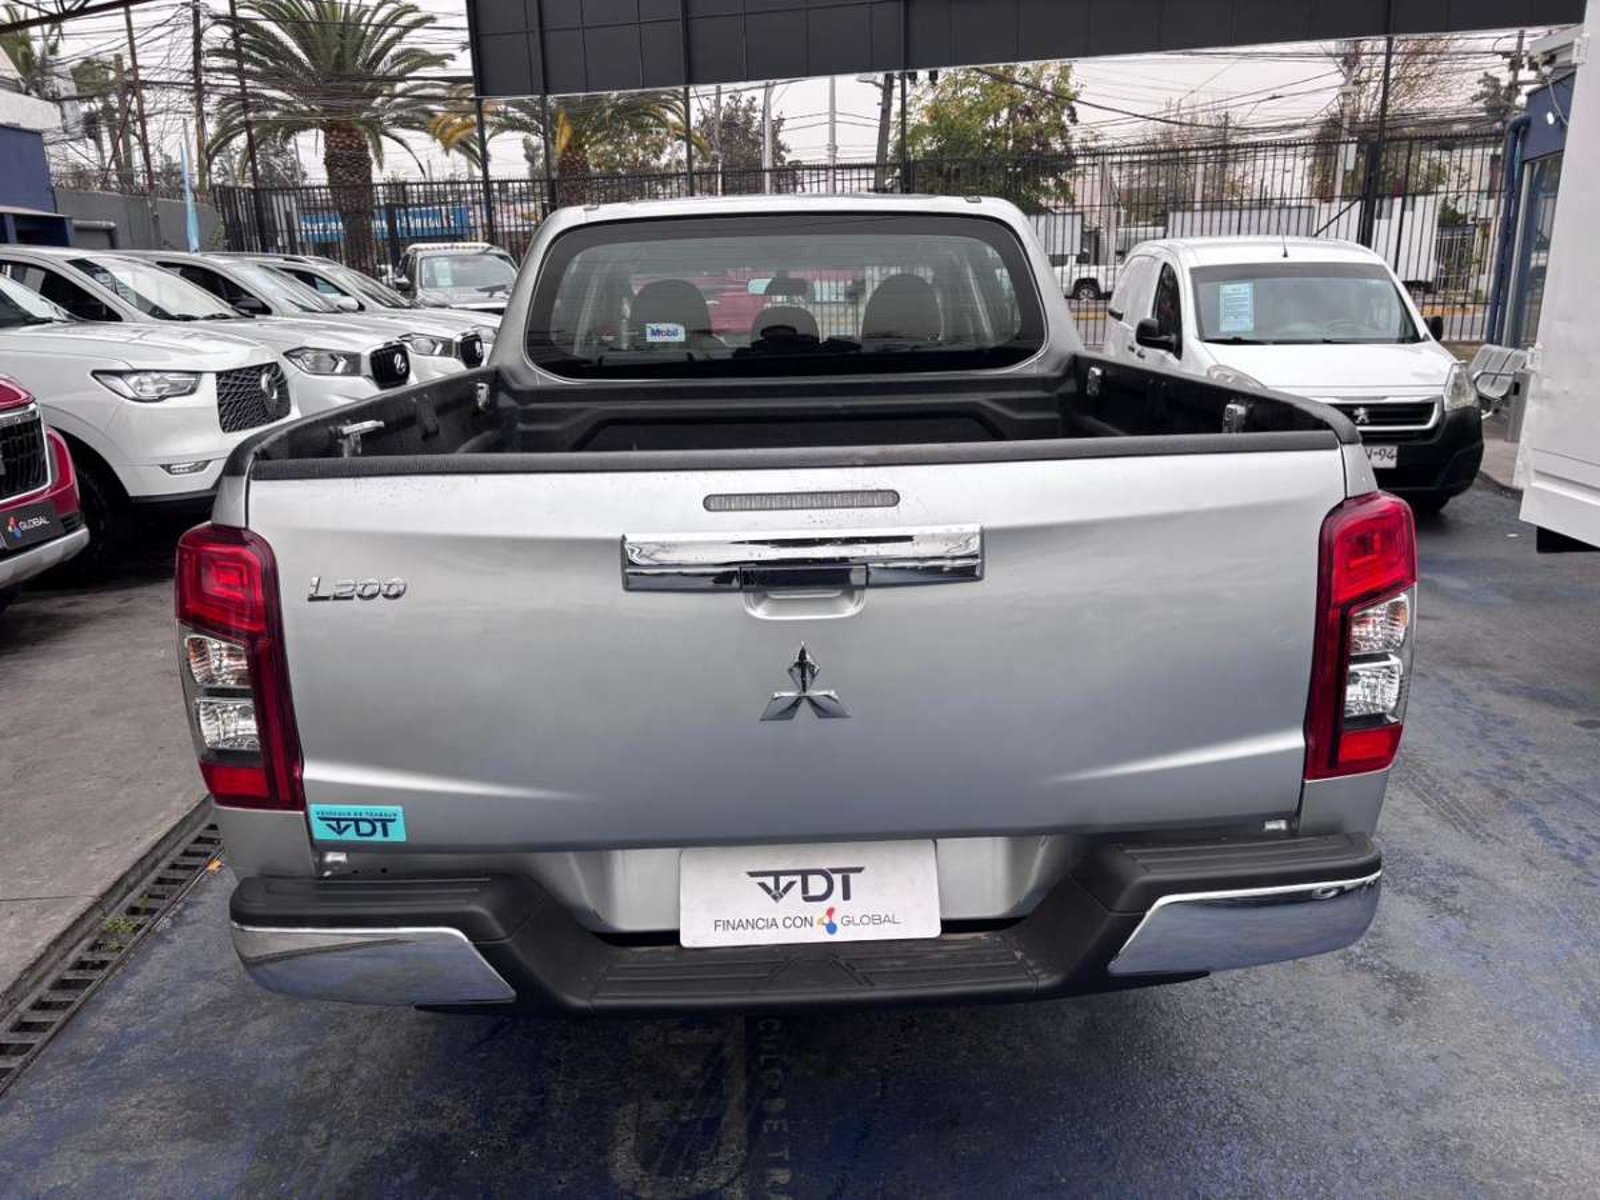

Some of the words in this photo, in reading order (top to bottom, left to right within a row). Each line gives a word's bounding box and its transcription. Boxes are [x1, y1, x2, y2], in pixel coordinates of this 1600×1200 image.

[307, 576, 407, 602] L200
[714, 916, 779, 932] FINANCIA
[782, 915, 814, 930] CON
[840, 913, 902, 927] GLOBAL
